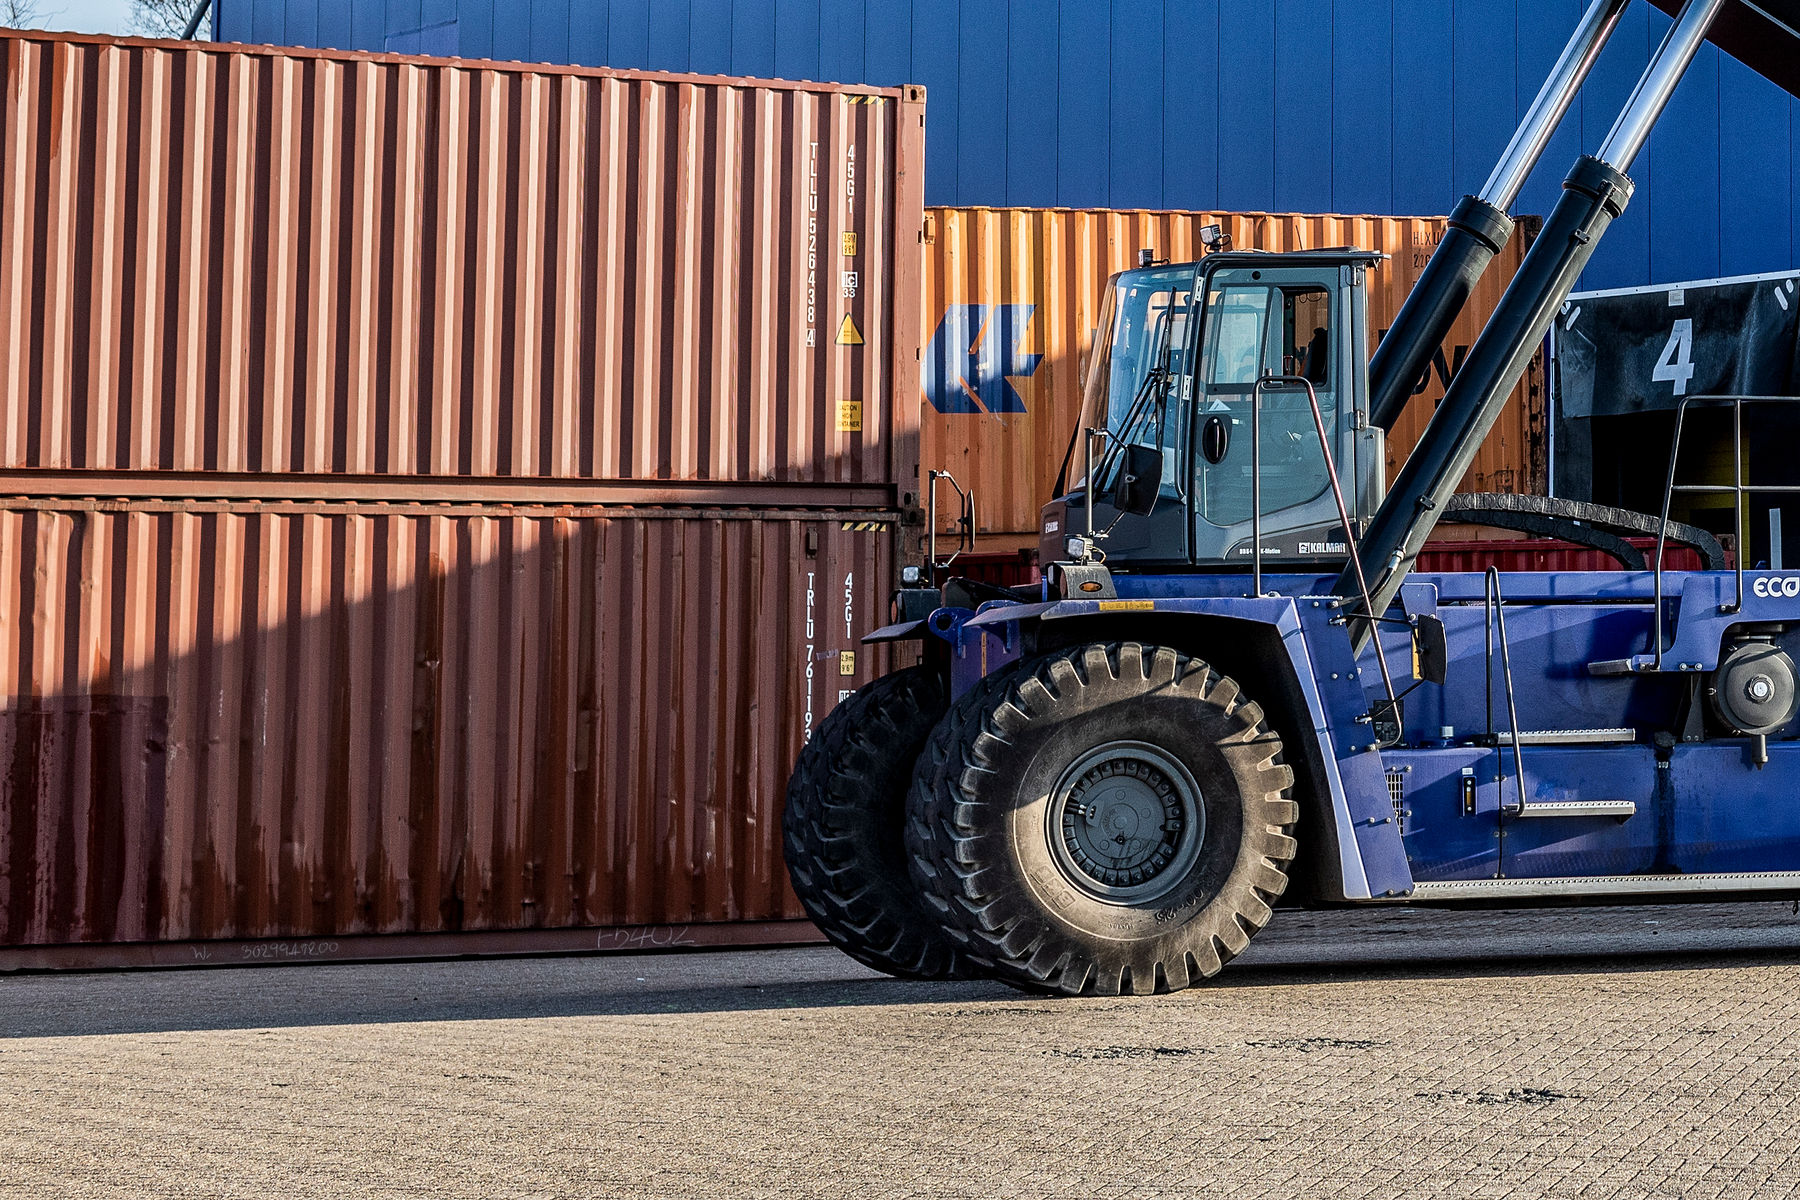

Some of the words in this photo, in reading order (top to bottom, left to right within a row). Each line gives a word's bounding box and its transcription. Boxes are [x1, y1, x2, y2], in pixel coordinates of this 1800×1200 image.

[809, 142, 819, 212] TLLU
[846, 144, 855, 214] 45G1
[807, 218, 817, 323] 526438
[1652, 318, 1695, 395] 4
[1311, 543, 1346, 553] KALMAR
[806, 572, 815, 639] TRLU
[844, 572, 853, 639] 45G1
